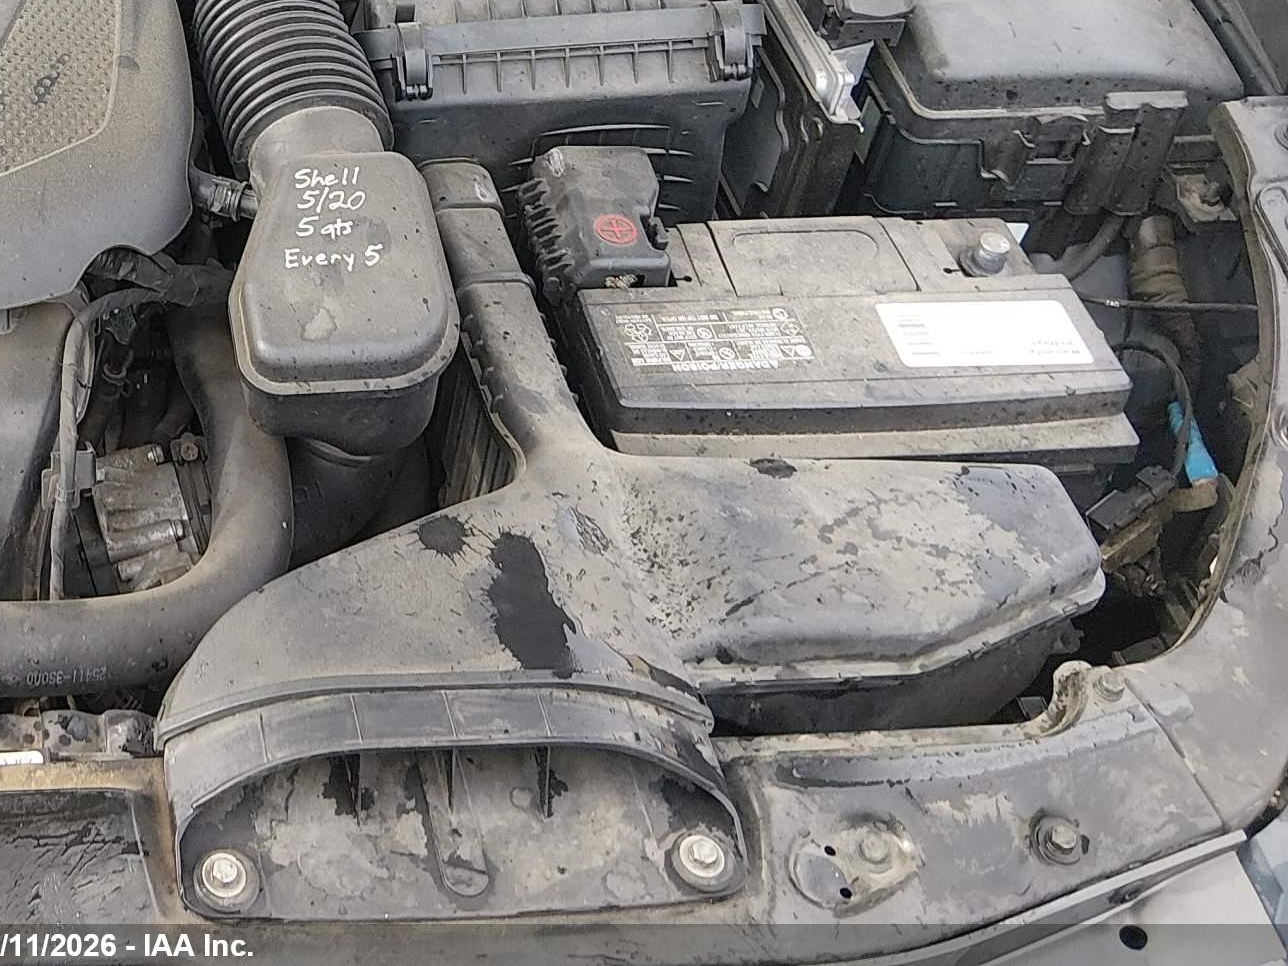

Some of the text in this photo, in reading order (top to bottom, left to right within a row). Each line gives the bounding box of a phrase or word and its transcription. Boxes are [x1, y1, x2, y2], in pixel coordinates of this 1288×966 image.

[294, 167, 360, 189] Shell
[296, 187, 365, 213] 5/20
[296, 215, 320, 237] 5
[284, 243, 383, 272] Every 5
